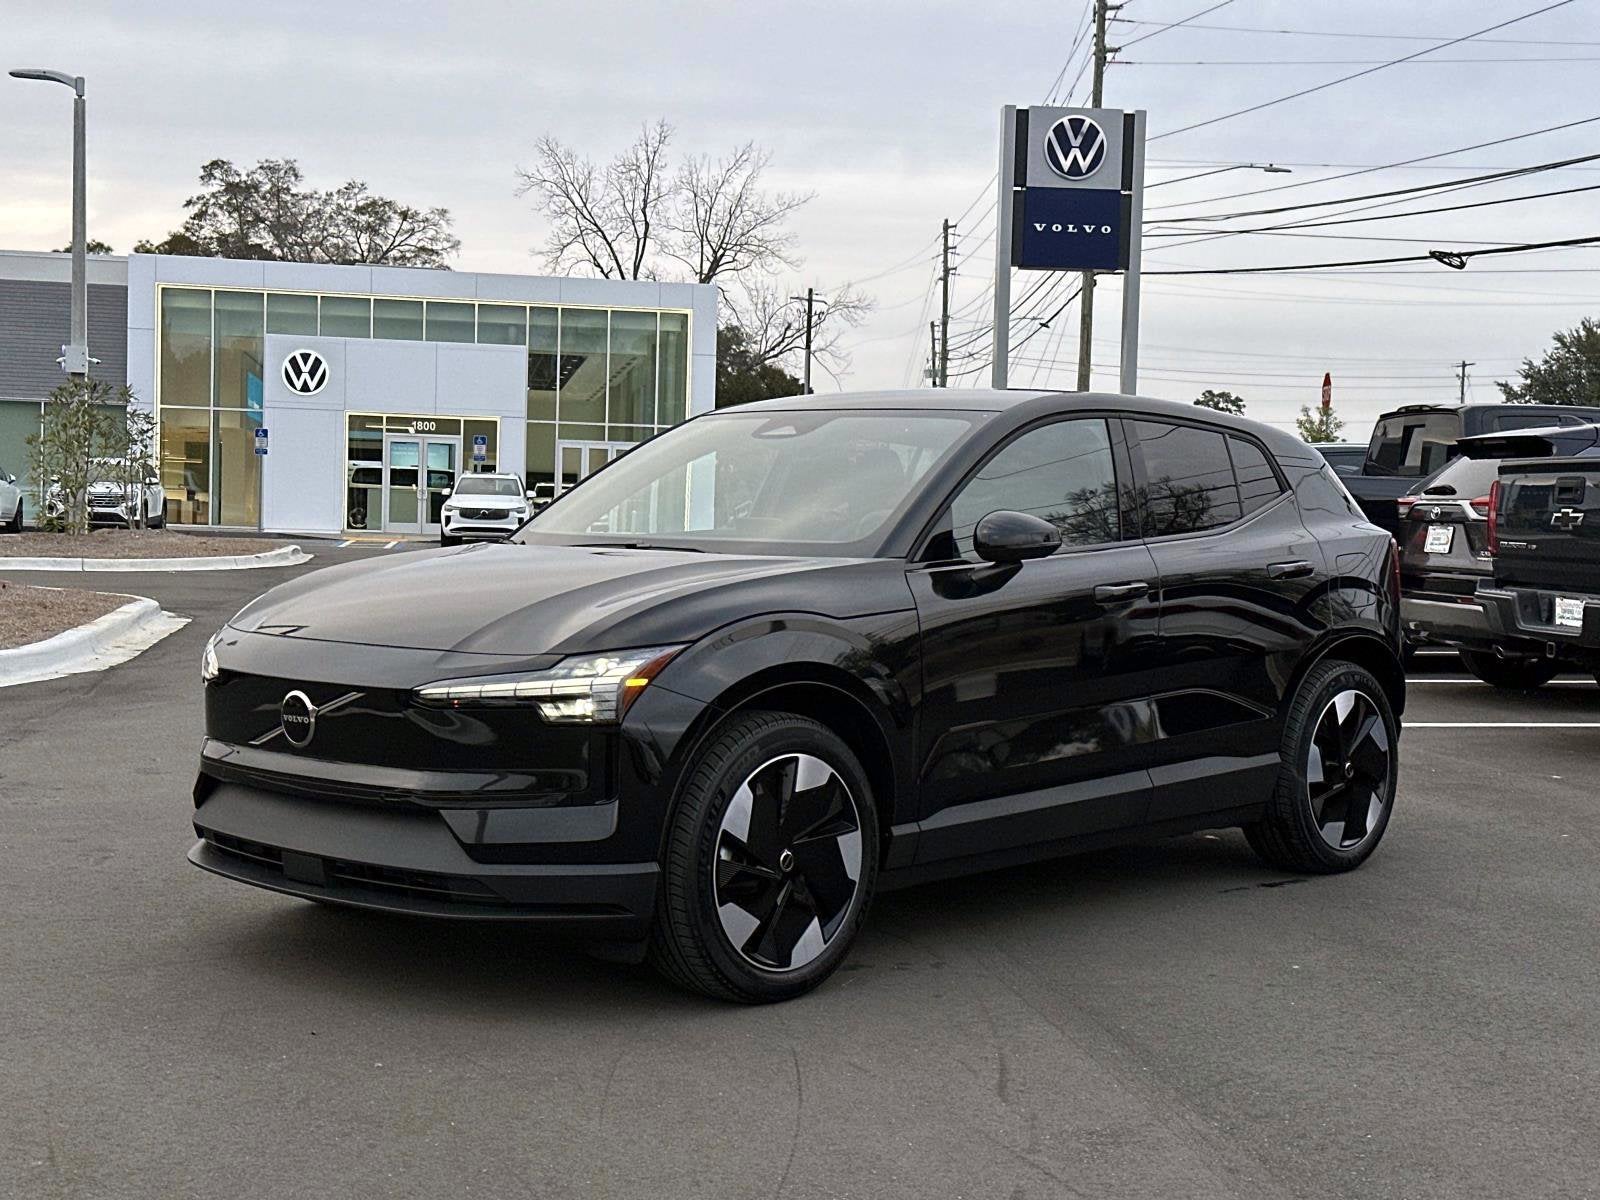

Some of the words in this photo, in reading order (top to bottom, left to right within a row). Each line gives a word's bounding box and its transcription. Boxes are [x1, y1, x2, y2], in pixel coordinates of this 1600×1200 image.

[1046, 116, 1106, 178] VW
[1033, 223, 1112, 234] VOLVO
[283, 350, 328, 394] VW
[411, 421, 436, 431] 1800
[283, 714, 309, 723] VOLVO
